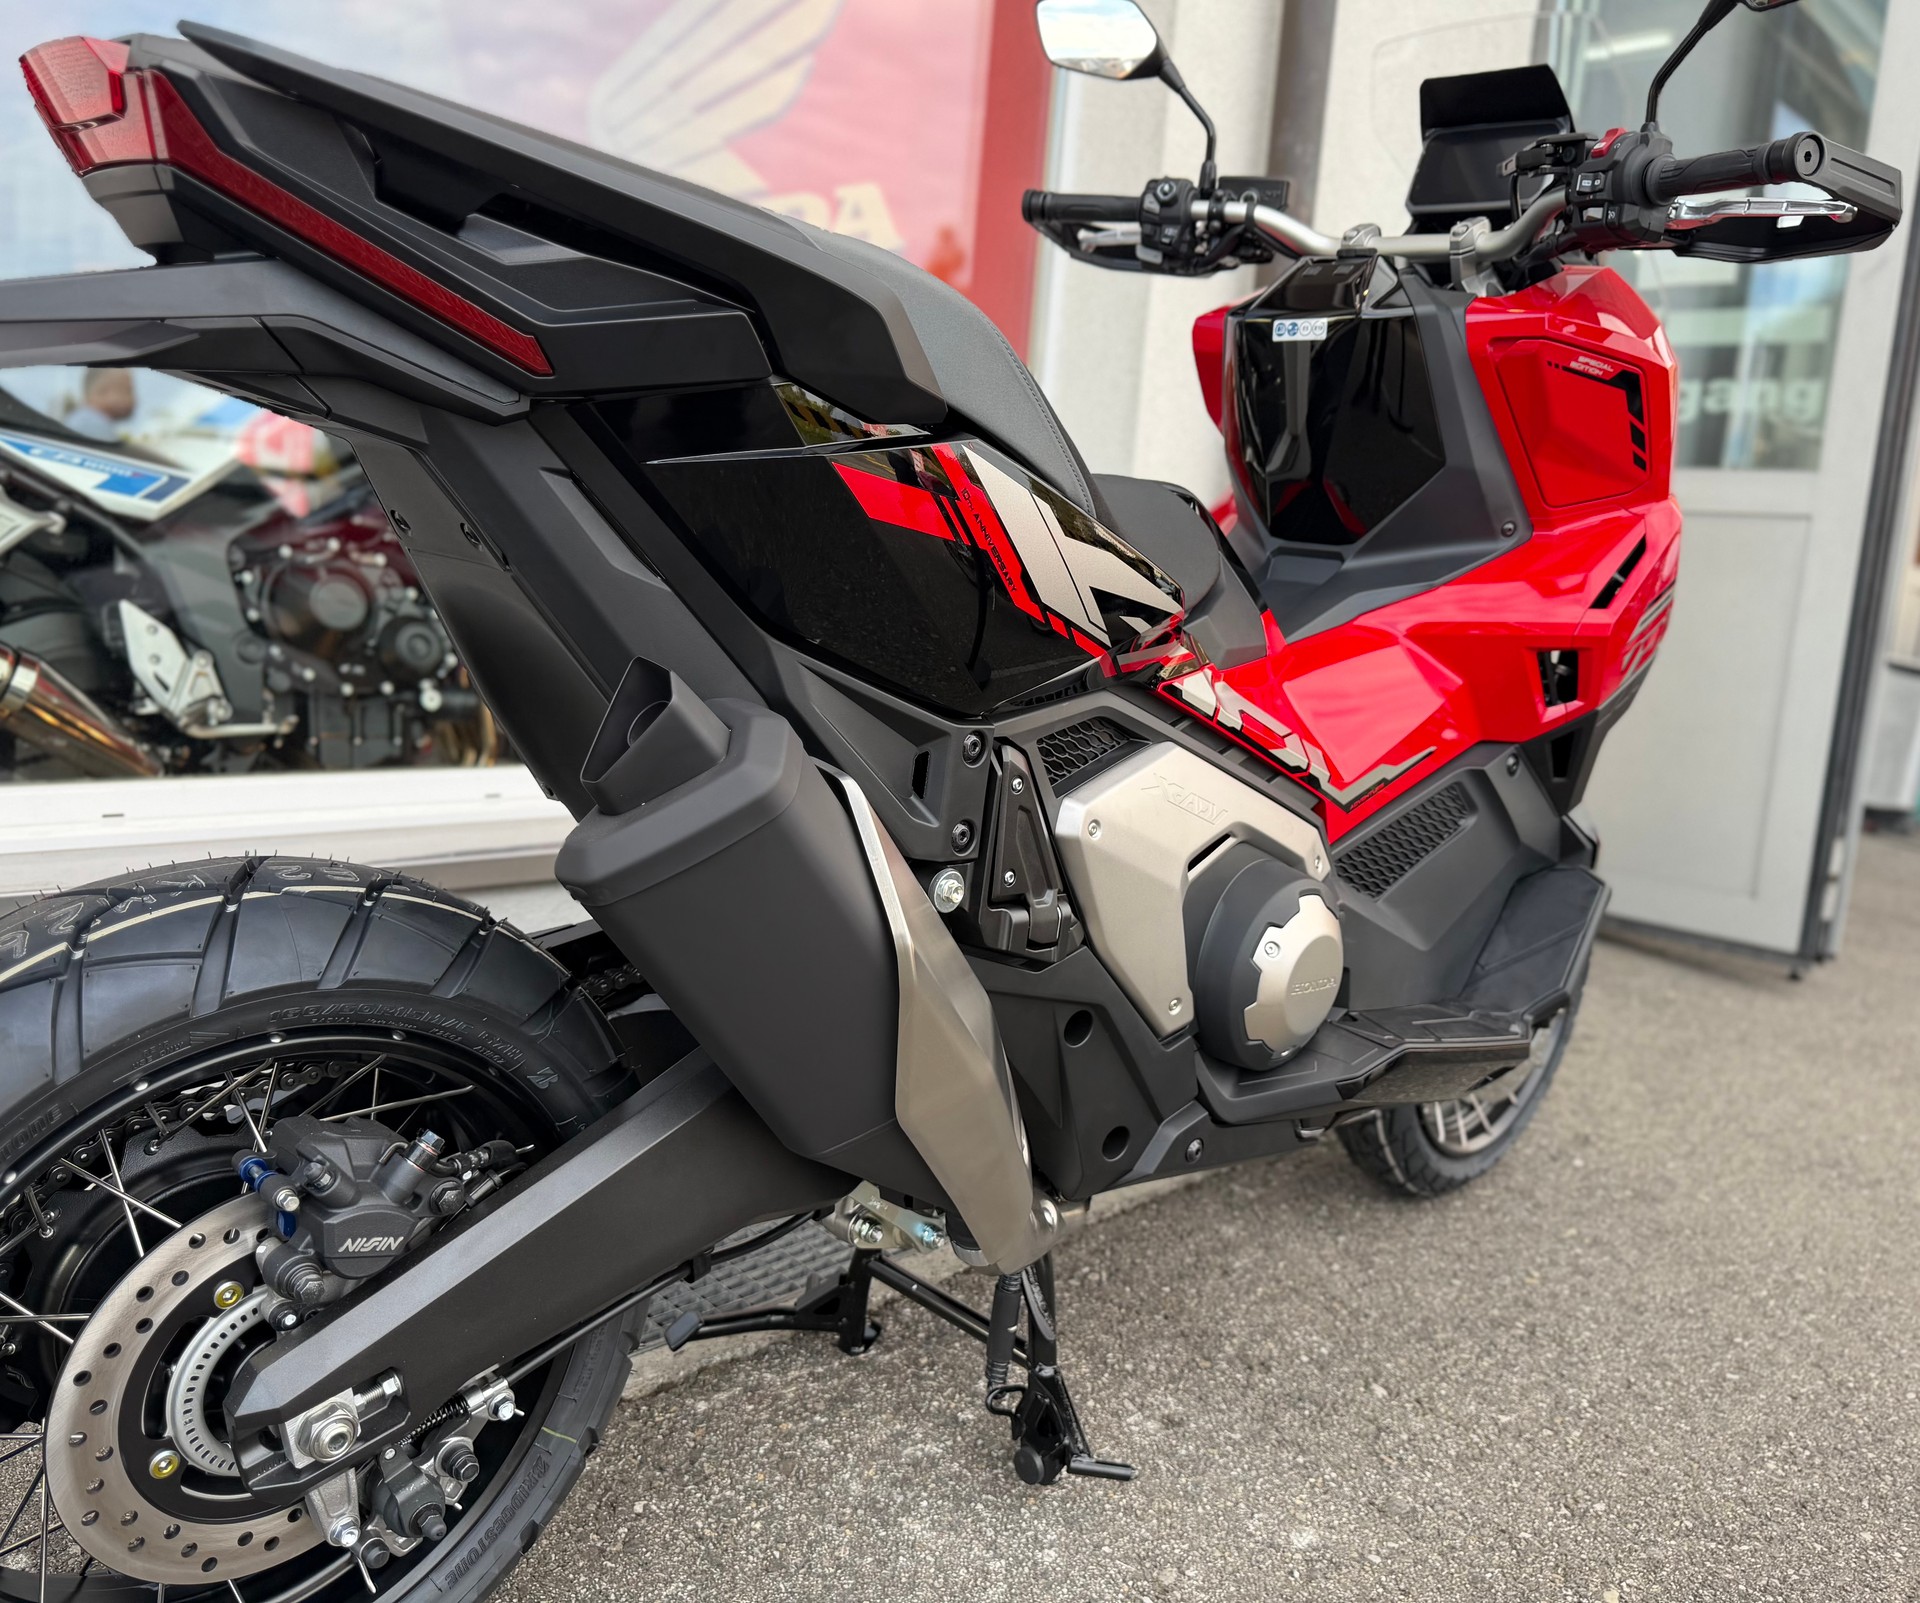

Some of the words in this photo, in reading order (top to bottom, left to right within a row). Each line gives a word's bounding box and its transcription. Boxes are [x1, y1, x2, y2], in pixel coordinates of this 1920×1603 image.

[972, 512, 1017, 593] ANNIVERSARY
[1290, 977, 1337, 997] HONDA
[444, 1454, 551, 1590] BRIDGESTONE
